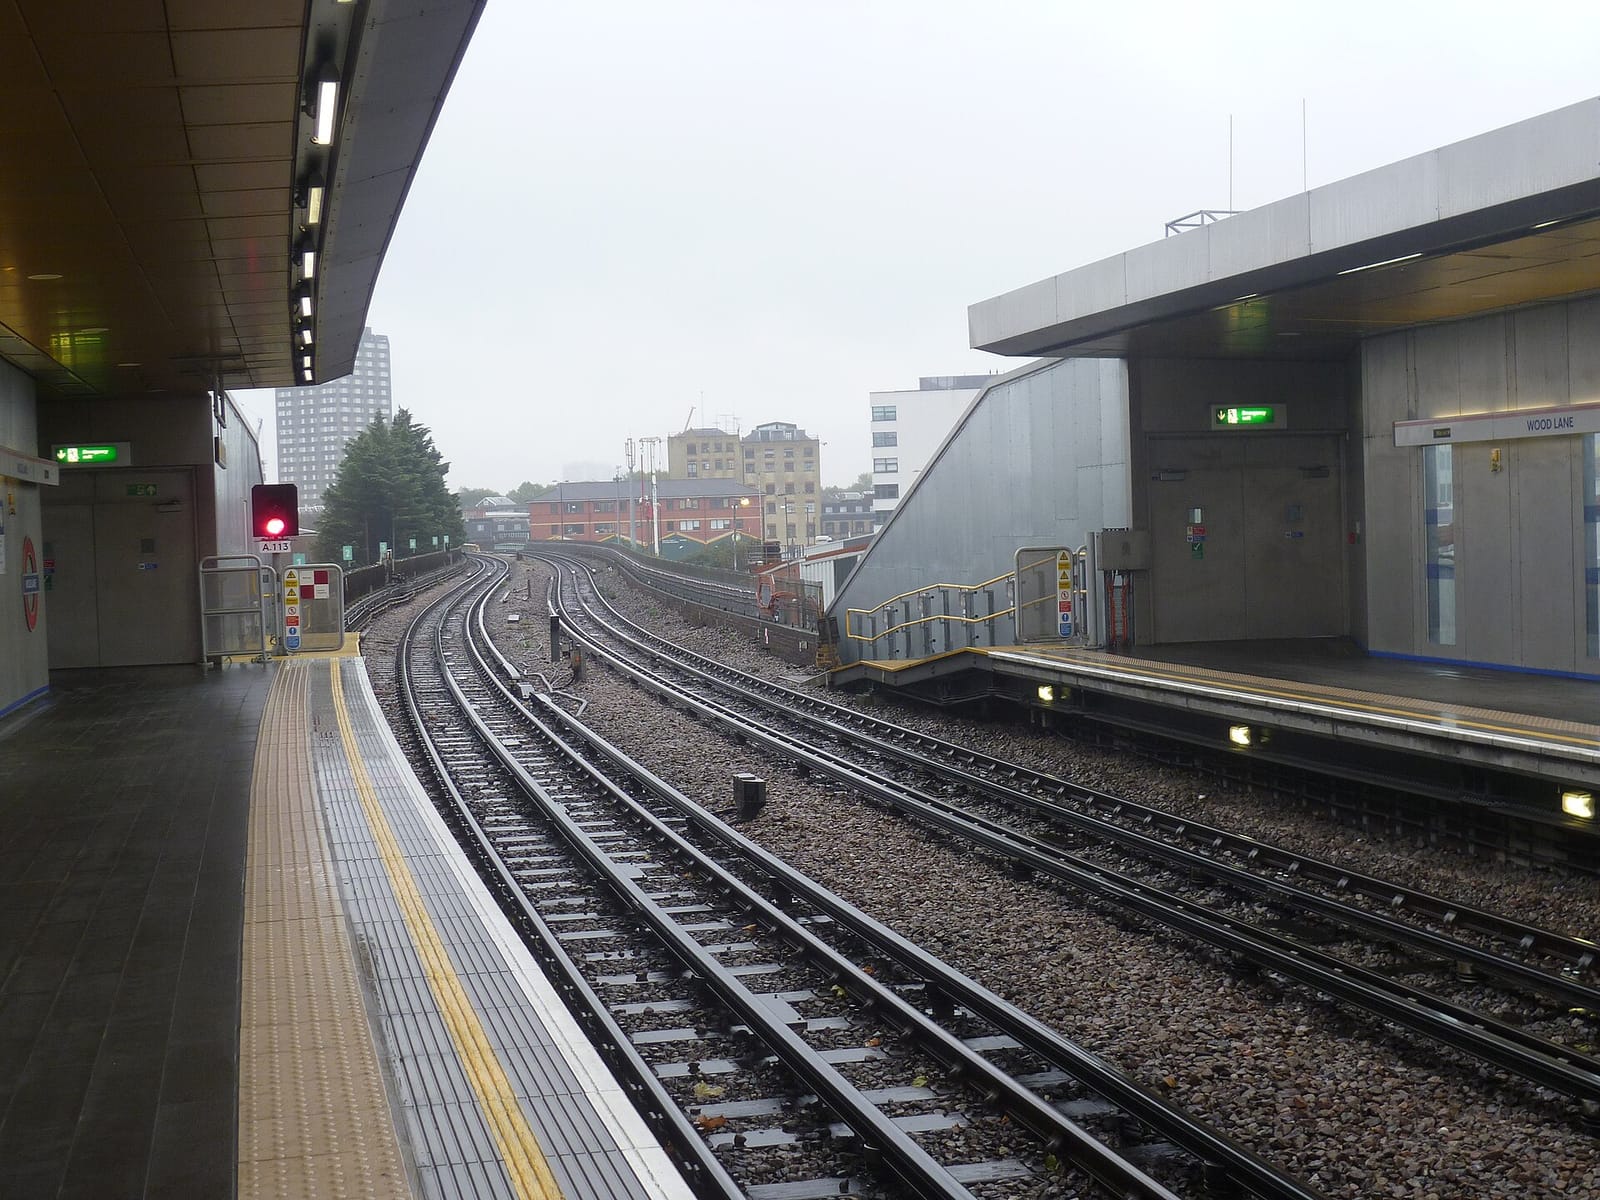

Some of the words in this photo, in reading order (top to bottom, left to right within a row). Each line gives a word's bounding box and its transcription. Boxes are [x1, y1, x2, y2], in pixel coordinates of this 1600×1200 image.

[1527, 418, 1552, 431] WOOD
[1554, 416, 1574, 429] LANE
[262, 542, 289, 552] A.113
